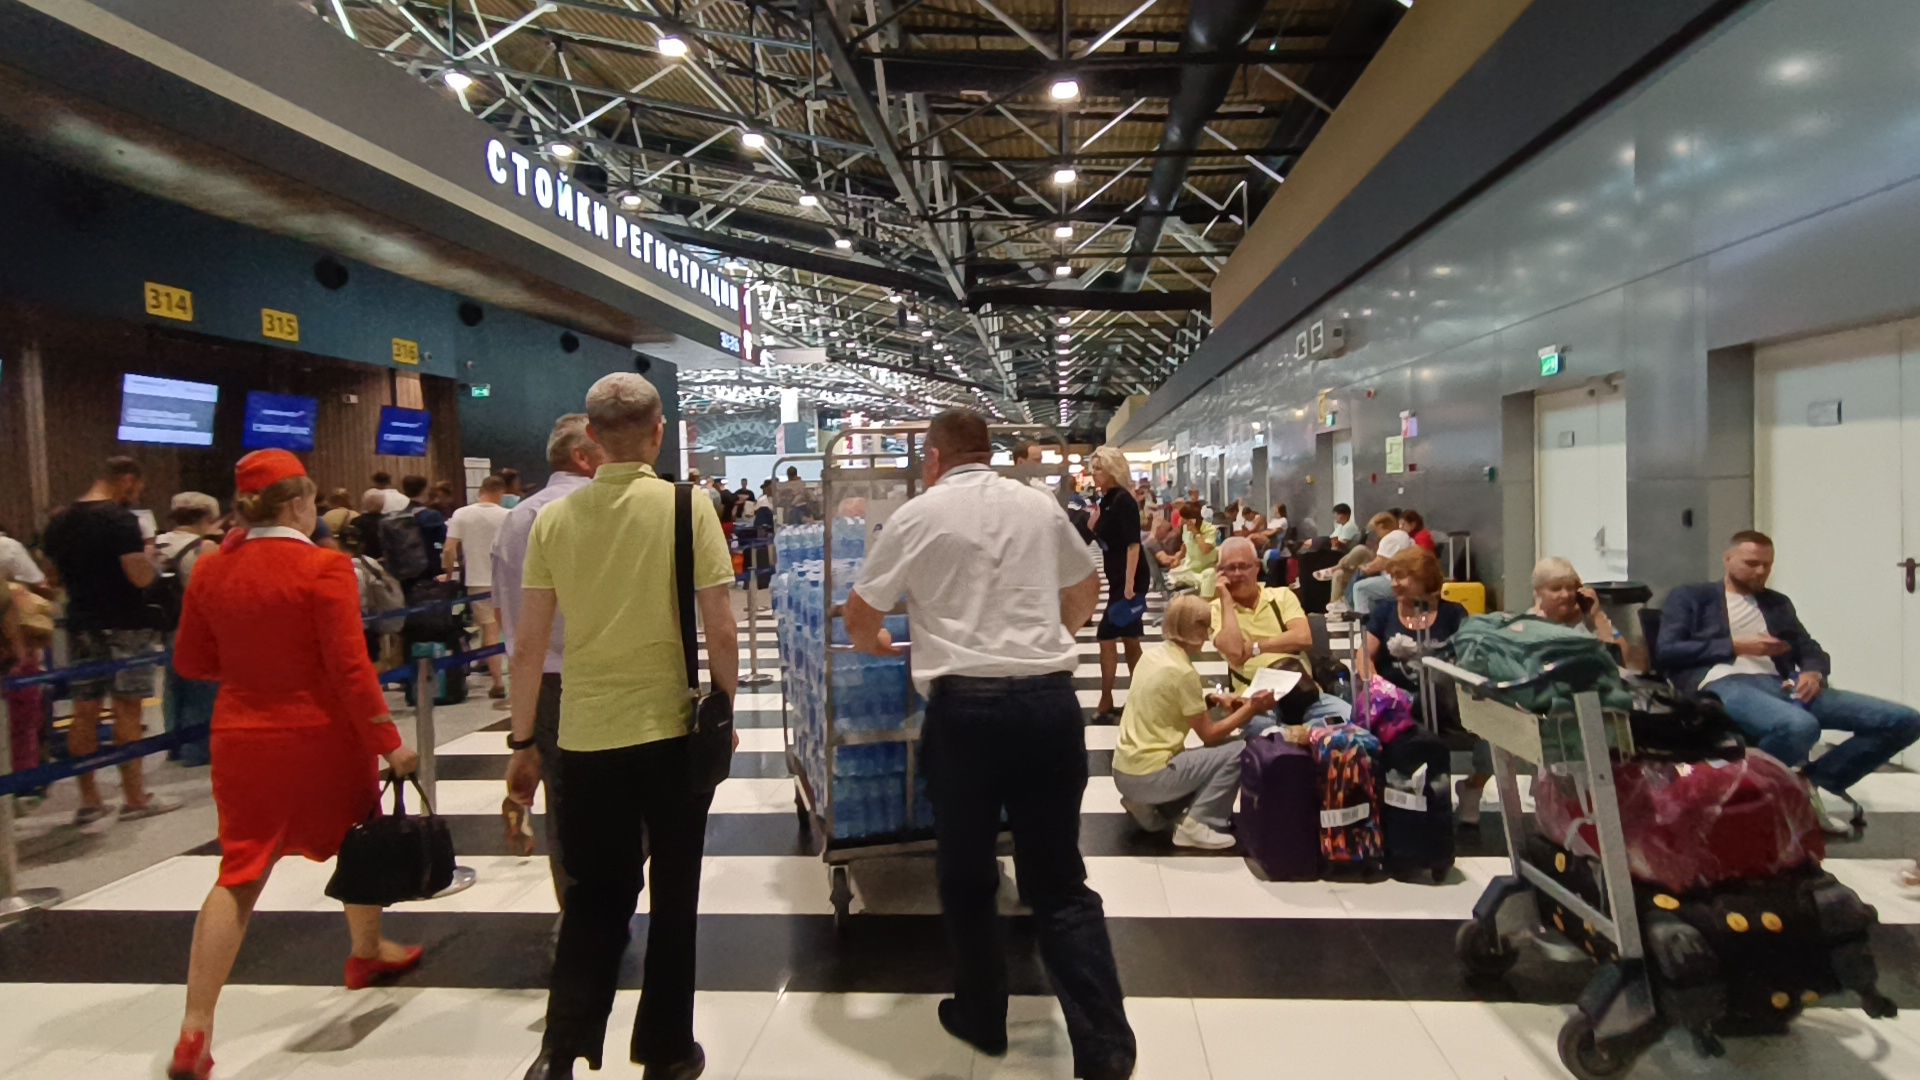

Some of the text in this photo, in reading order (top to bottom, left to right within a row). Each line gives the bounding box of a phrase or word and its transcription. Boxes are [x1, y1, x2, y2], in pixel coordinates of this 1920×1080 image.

[485, 138, 739, 312] СТОЙКИ РЕГИСТРАЦИИ
[148, 288, 188, 314] 314
[265, 313, 297, 337] 315
